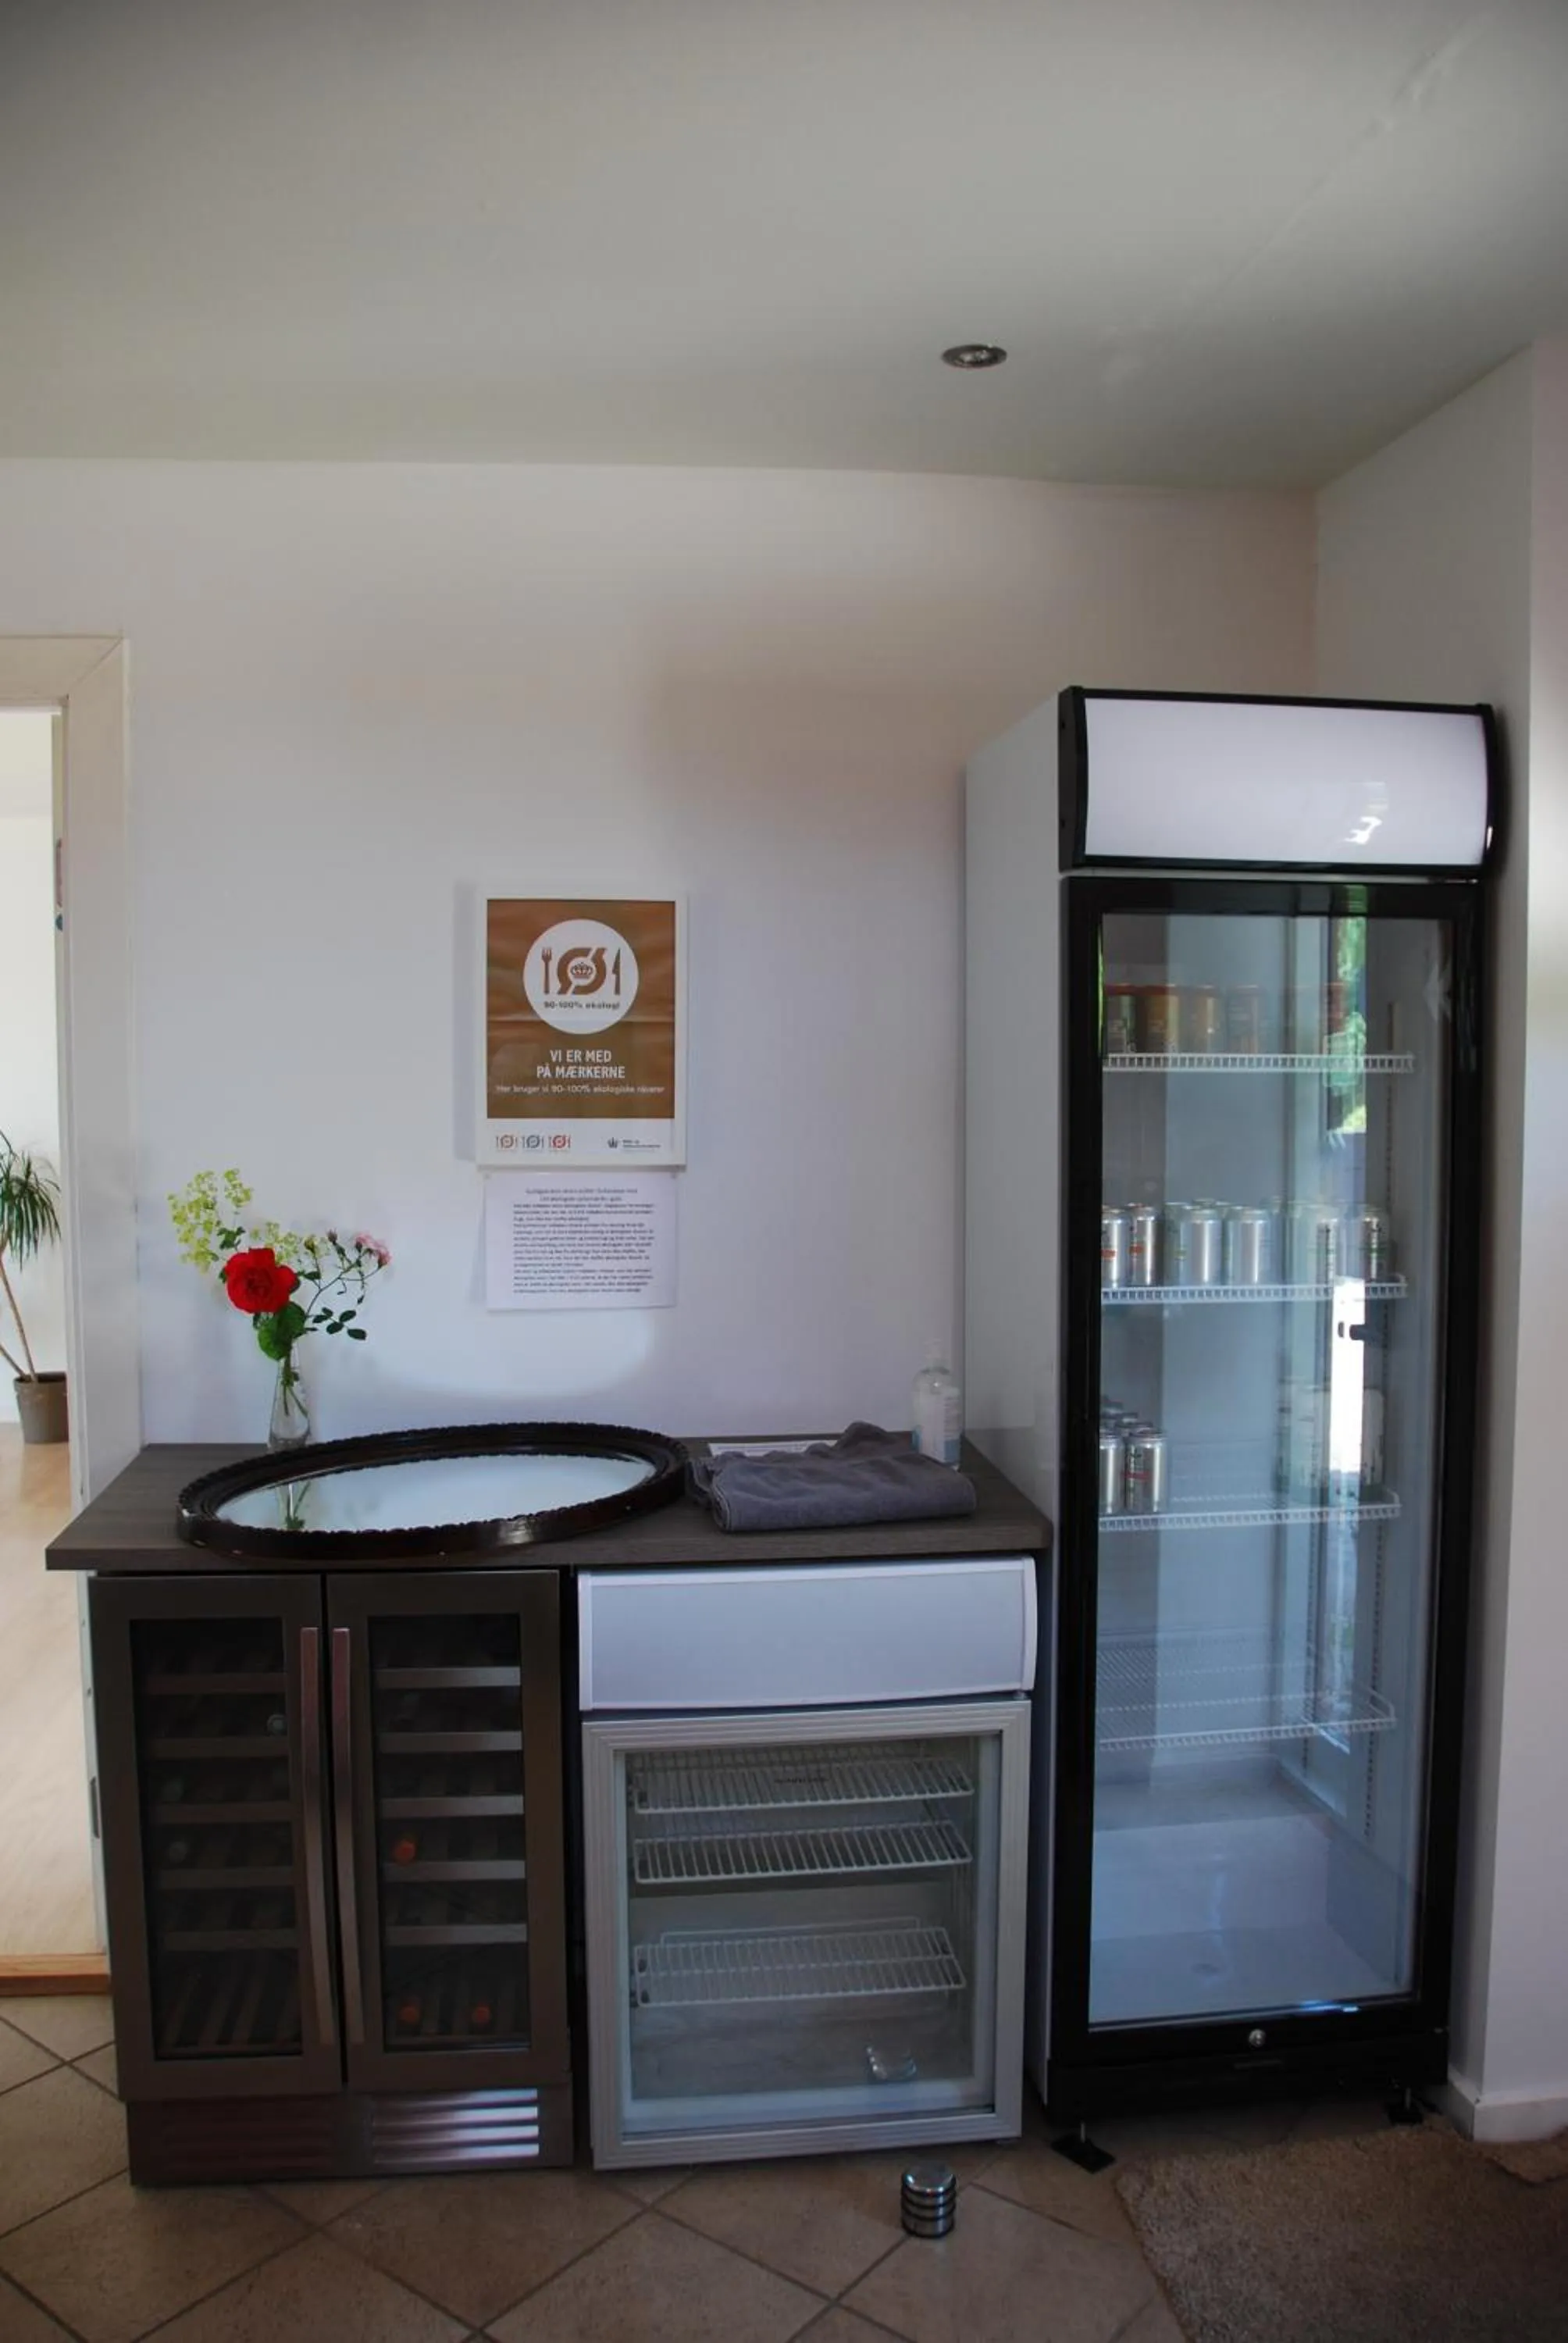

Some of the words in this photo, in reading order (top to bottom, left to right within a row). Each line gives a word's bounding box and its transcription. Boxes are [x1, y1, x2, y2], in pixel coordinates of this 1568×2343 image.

[550, 1050, 562, 1062] VI
[566, 1050, 582, 1062] ER
[585, 1050, 612, 1063] MED
[536, 1062, 551, 1078] PÅ
[555, 1066, 625, 1079] MÆRKERNE
[513, 1086, 540, 1095] bruger
[551, 1085, 590, 1093] 90-100%
